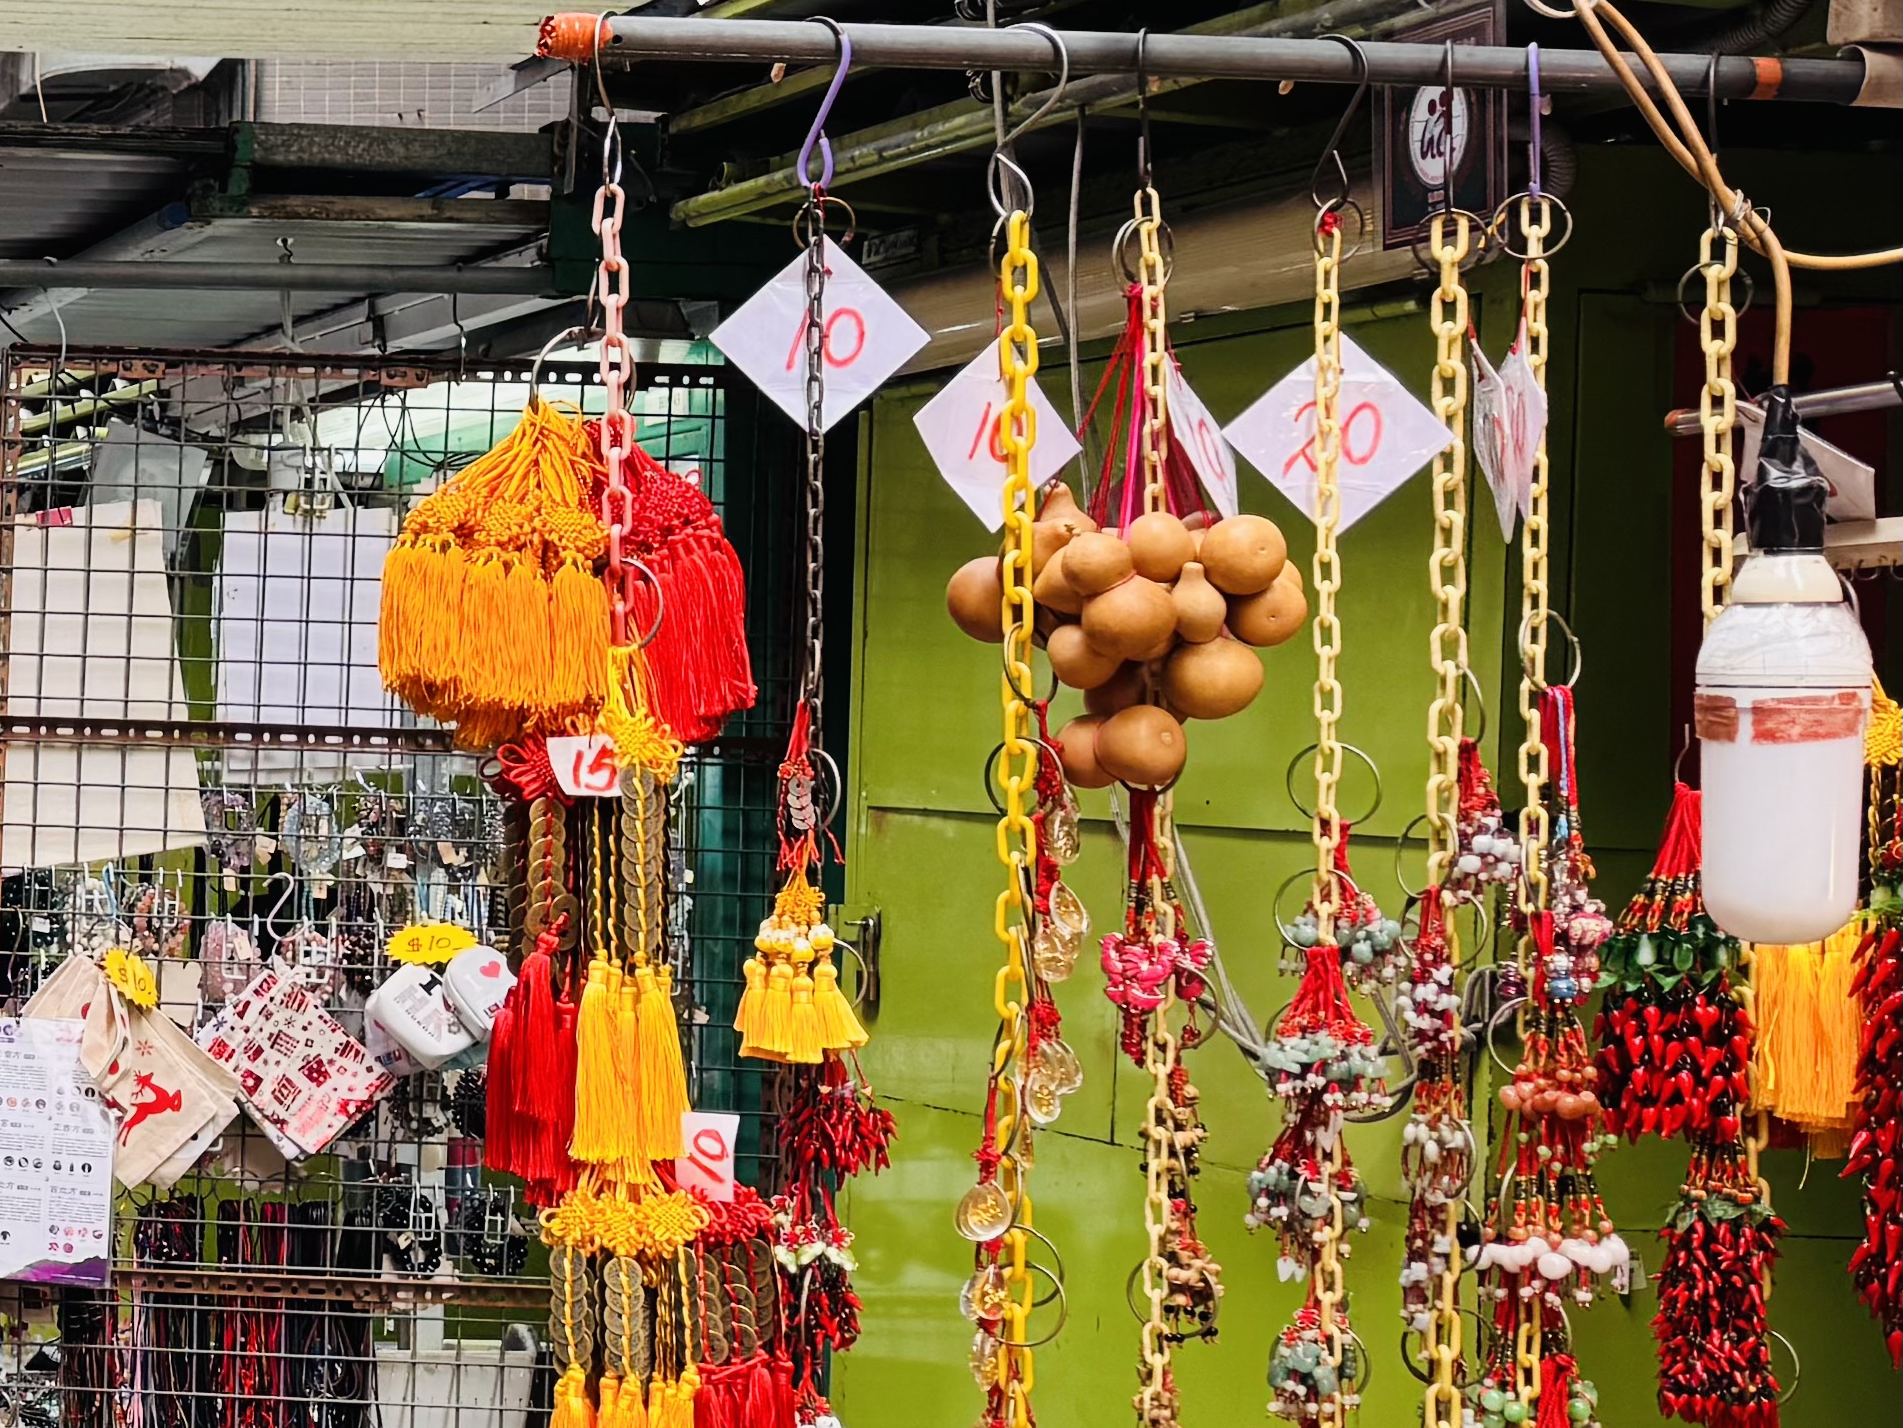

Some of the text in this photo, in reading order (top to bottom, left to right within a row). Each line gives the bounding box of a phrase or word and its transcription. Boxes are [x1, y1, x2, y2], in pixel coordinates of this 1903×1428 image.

[1282, 400, 1384, 480] 20
[572, 748, 616, 791] 15
[687, 1129, 729, 1186] 10
